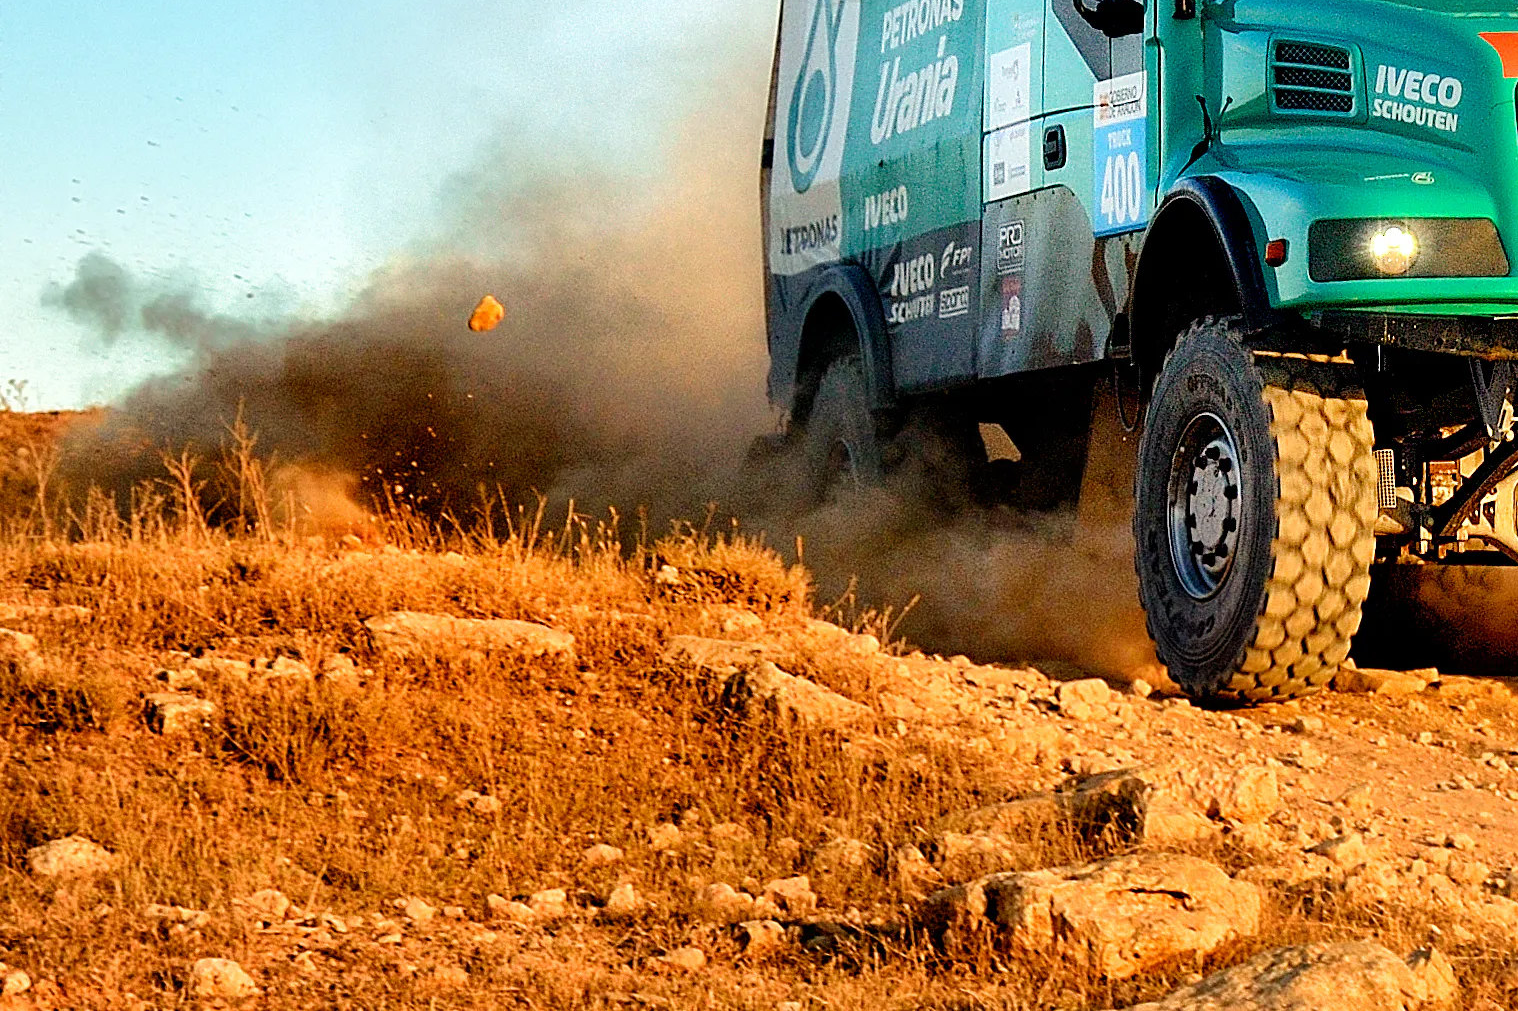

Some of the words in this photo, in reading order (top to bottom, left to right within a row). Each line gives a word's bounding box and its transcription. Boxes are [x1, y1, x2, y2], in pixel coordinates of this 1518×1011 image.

[870, 35, 959, 144] Urania
[1375, 64, 1462, 108] IVECO
[1372, 98, 1459, 132] SCHOUTEN
[864, 185, 908, 231] IVECO
[1101, 151, 1140, 225] 400
[1000, 224, 1023, 248] PRO
[890, 253, 935, 297] IVECO
